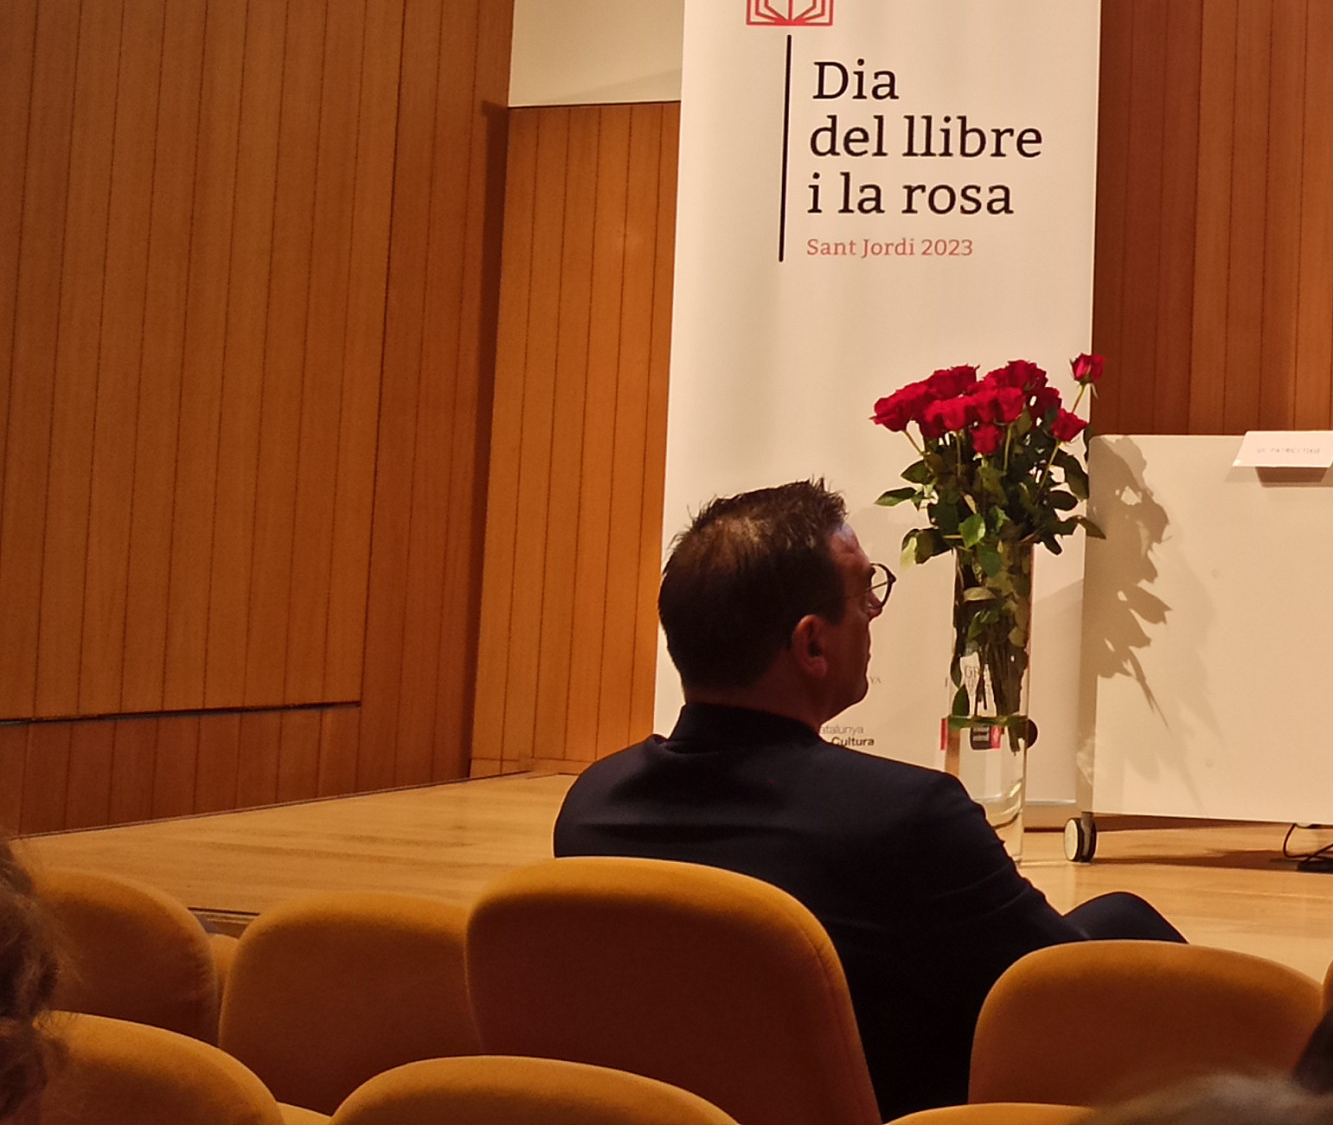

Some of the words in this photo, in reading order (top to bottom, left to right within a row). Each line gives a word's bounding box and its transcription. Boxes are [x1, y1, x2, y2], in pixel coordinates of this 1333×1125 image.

[812, 58, 900, 101] Dia
[810, 114, 889, 158] del
[901, 114, 1043, 159] llibre
[806, 172, 824, 215] i
[837, 172, 886, 215] la
[901, 183, 1015, 216] rosa
[806, 238, 857, 257] Sant
[861, 237, 916, 259] Jordi
[920, 238, 974, 257] 2023
[819, 725, 864, 736] atalunya
[831, 736, 875, 747] Cultura
